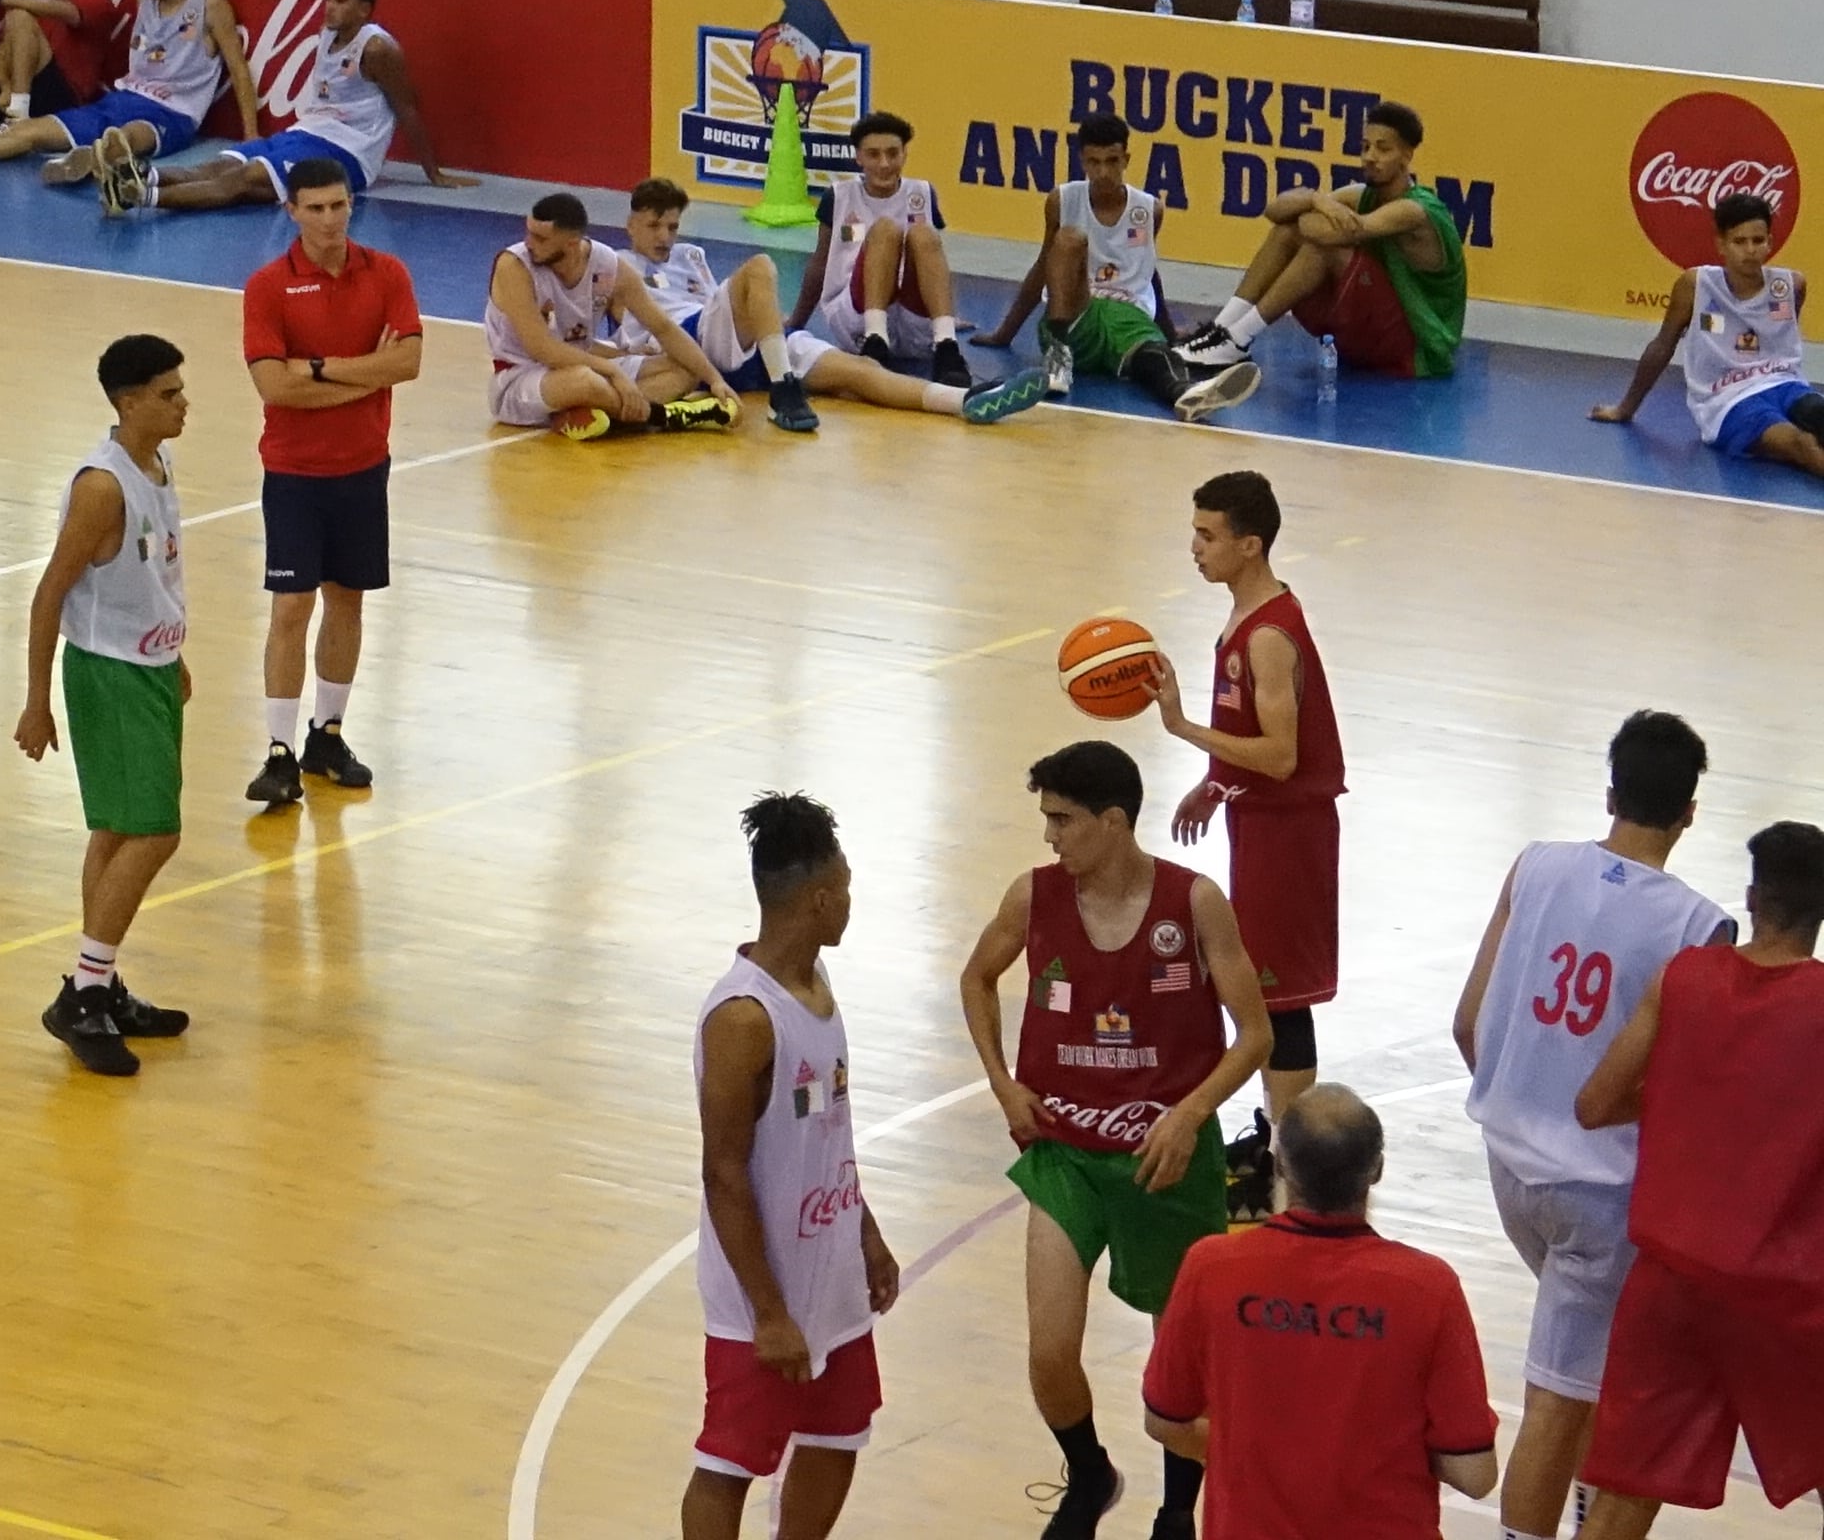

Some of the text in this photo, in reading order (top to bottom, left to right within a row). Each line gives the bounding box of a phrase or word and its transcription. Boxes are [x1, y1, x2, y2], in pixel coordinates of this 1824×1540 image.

[703, 126, 760, 150] BUCKET
[1069, 59, 1381, 156] BUCKET
[1143, 142, 1189, 211] A
[1533, 942, 1613, 1036] 39
[1237, 1293, 1385, 1339] COACH
